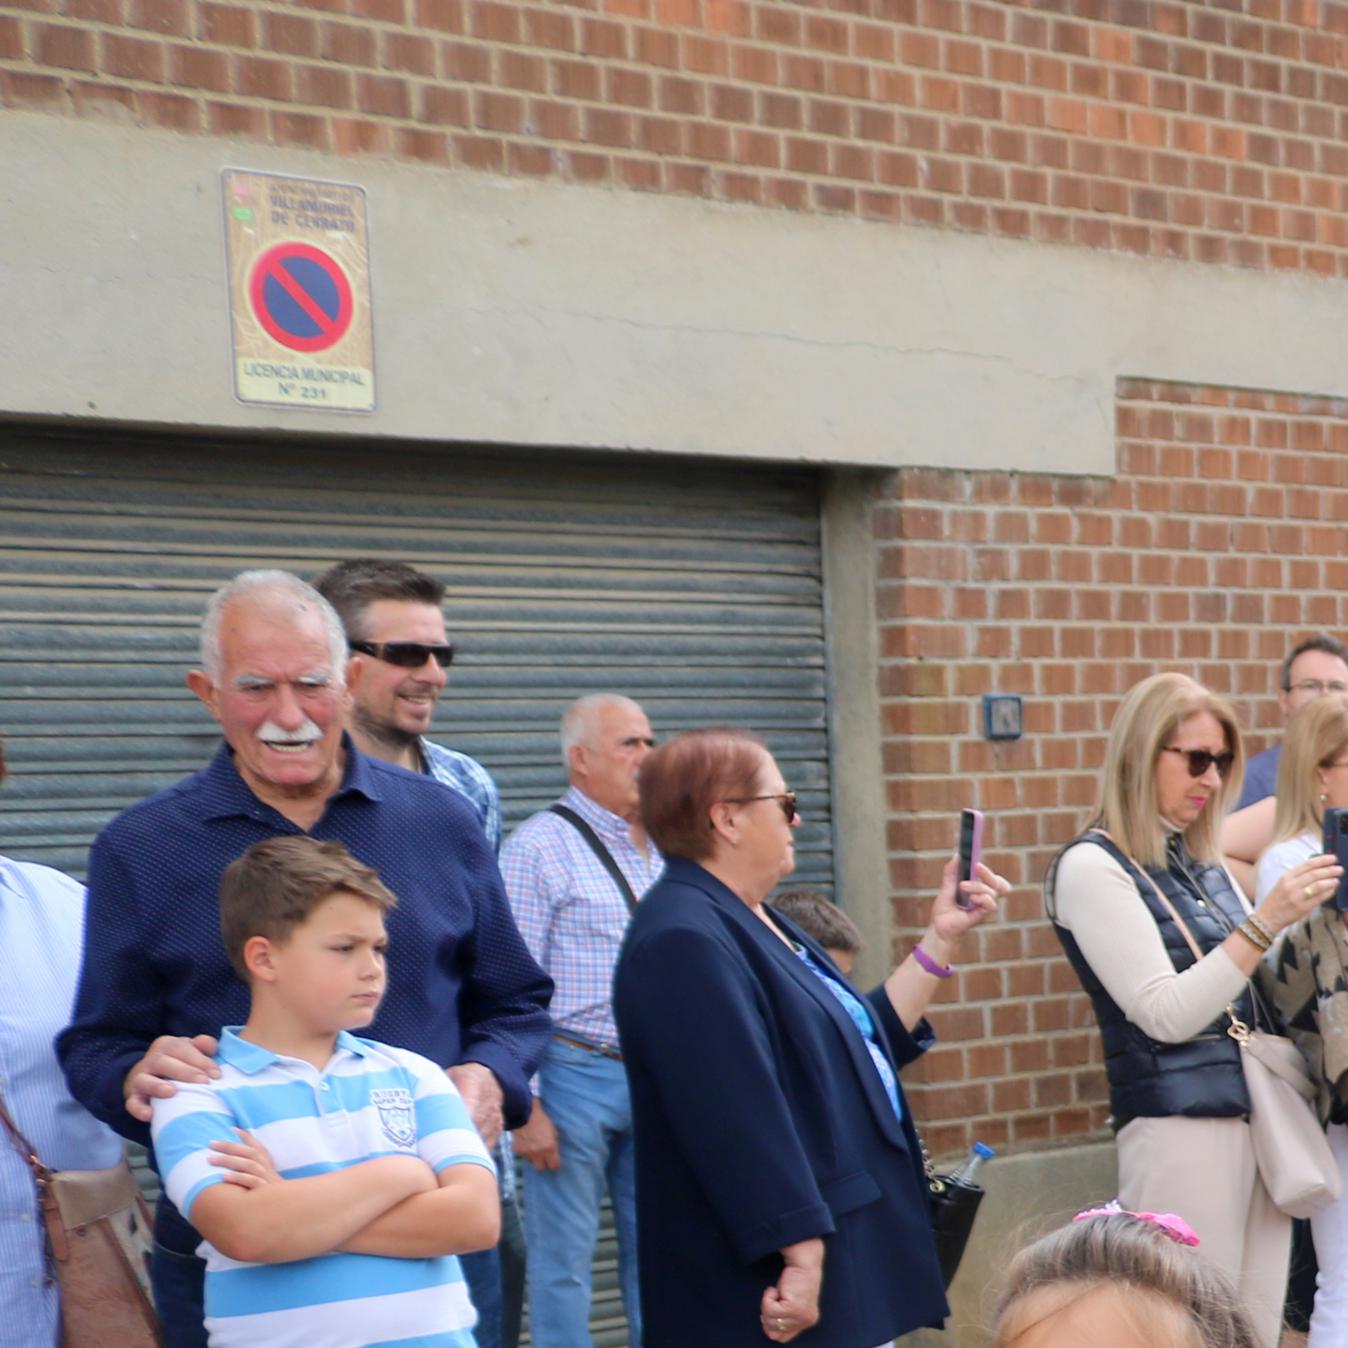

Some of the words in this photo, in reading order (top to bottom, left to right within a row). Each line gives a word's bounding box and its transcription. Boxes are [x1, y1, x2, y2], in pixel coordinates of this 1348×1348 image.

[244, 362, 300, 380] LICENCIA
[301, 366, 366, 385] MUNICIPAL
[300, 385, 327, 399] 231
